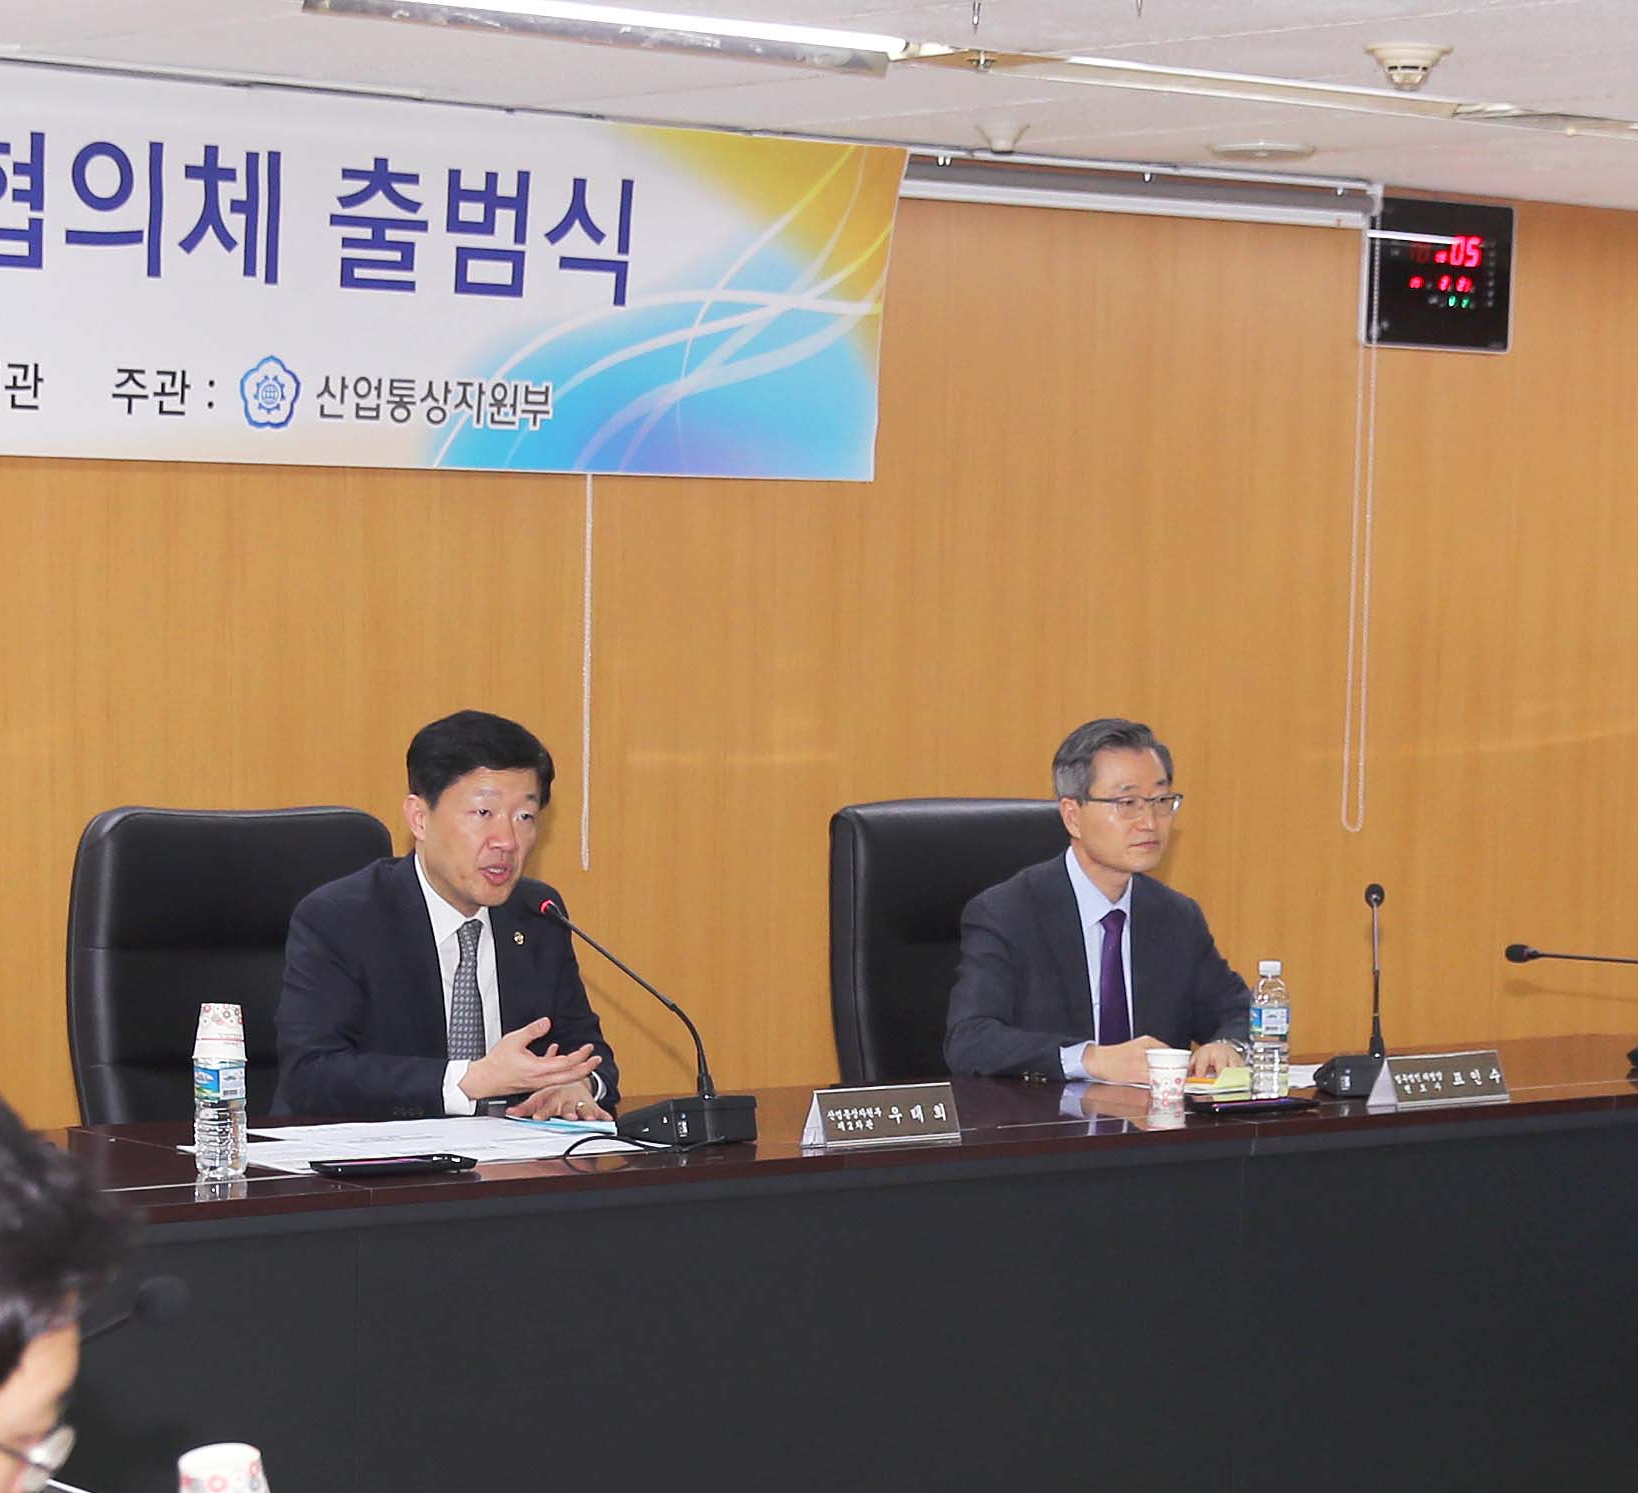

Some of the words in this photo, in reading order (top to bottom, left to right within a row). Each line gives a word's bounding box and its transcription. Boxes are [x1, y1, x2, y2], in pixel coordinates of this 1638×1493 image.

[328, 155, 636, 308] 출범식
[110, 367, 192, 417] 주관
[315, 374, 555, 428] 산업통상자원부
